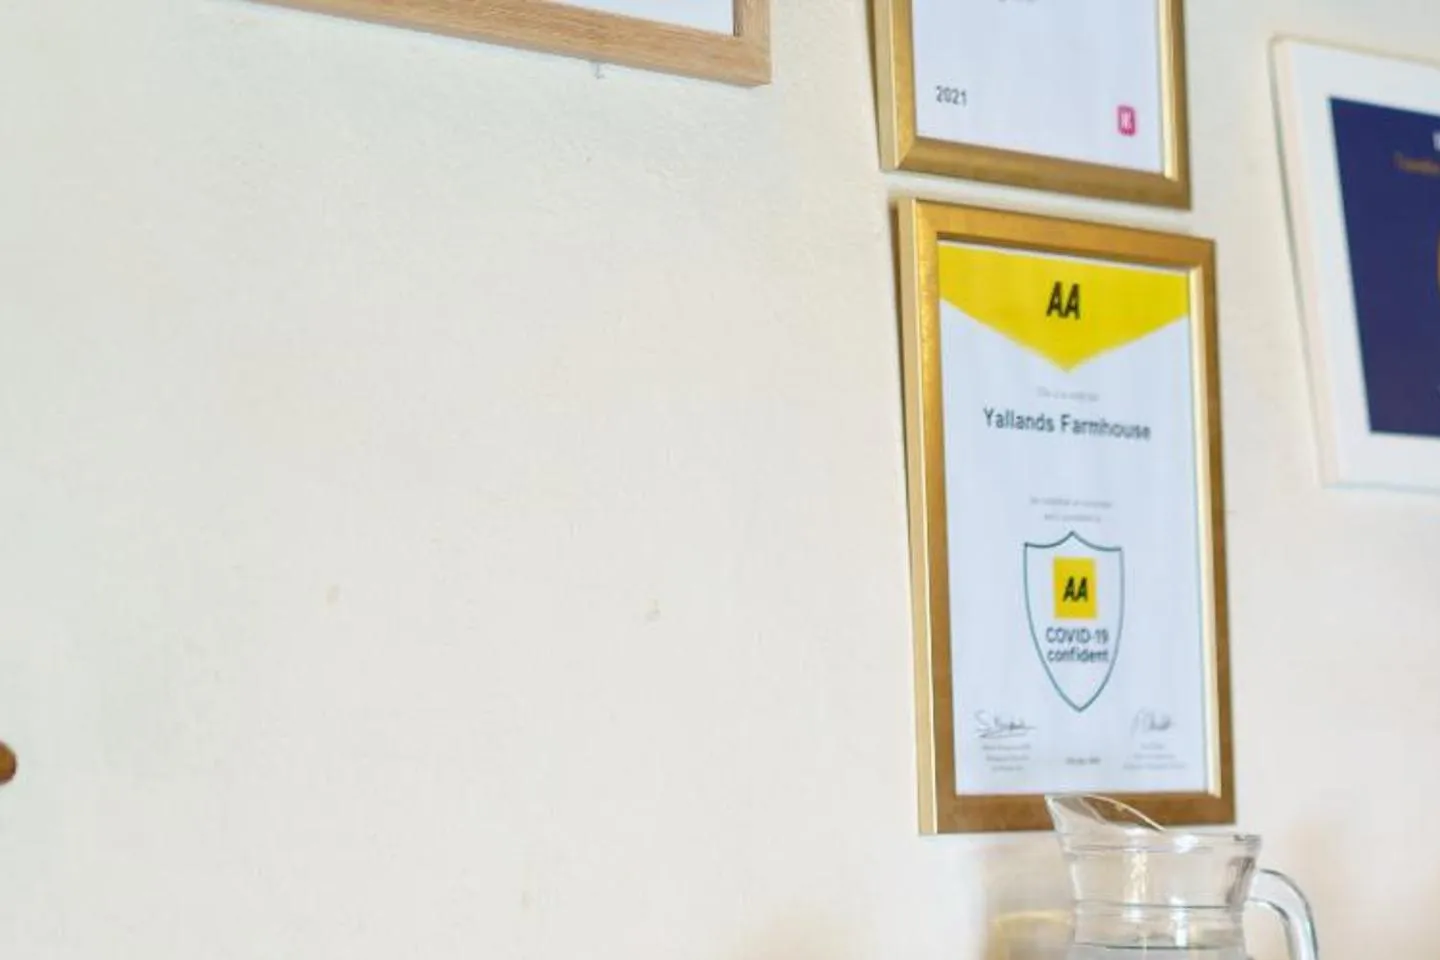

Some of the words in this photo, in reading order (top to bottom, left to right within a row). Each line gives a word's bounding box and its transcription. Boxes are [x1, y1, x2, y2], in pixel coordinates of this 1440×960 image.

[936, 85, 967, 105] 2021
[1046, 280, 1081, 319] AA
[983, 408, 1055, 433] Yallands
[1061, 413, 1151, 441] Farmhouse
[1062, 576, 1089, 602] AA
[1046, 626, 1109, 645] COVID-19
[1047, 645, 1109, 663] confident
